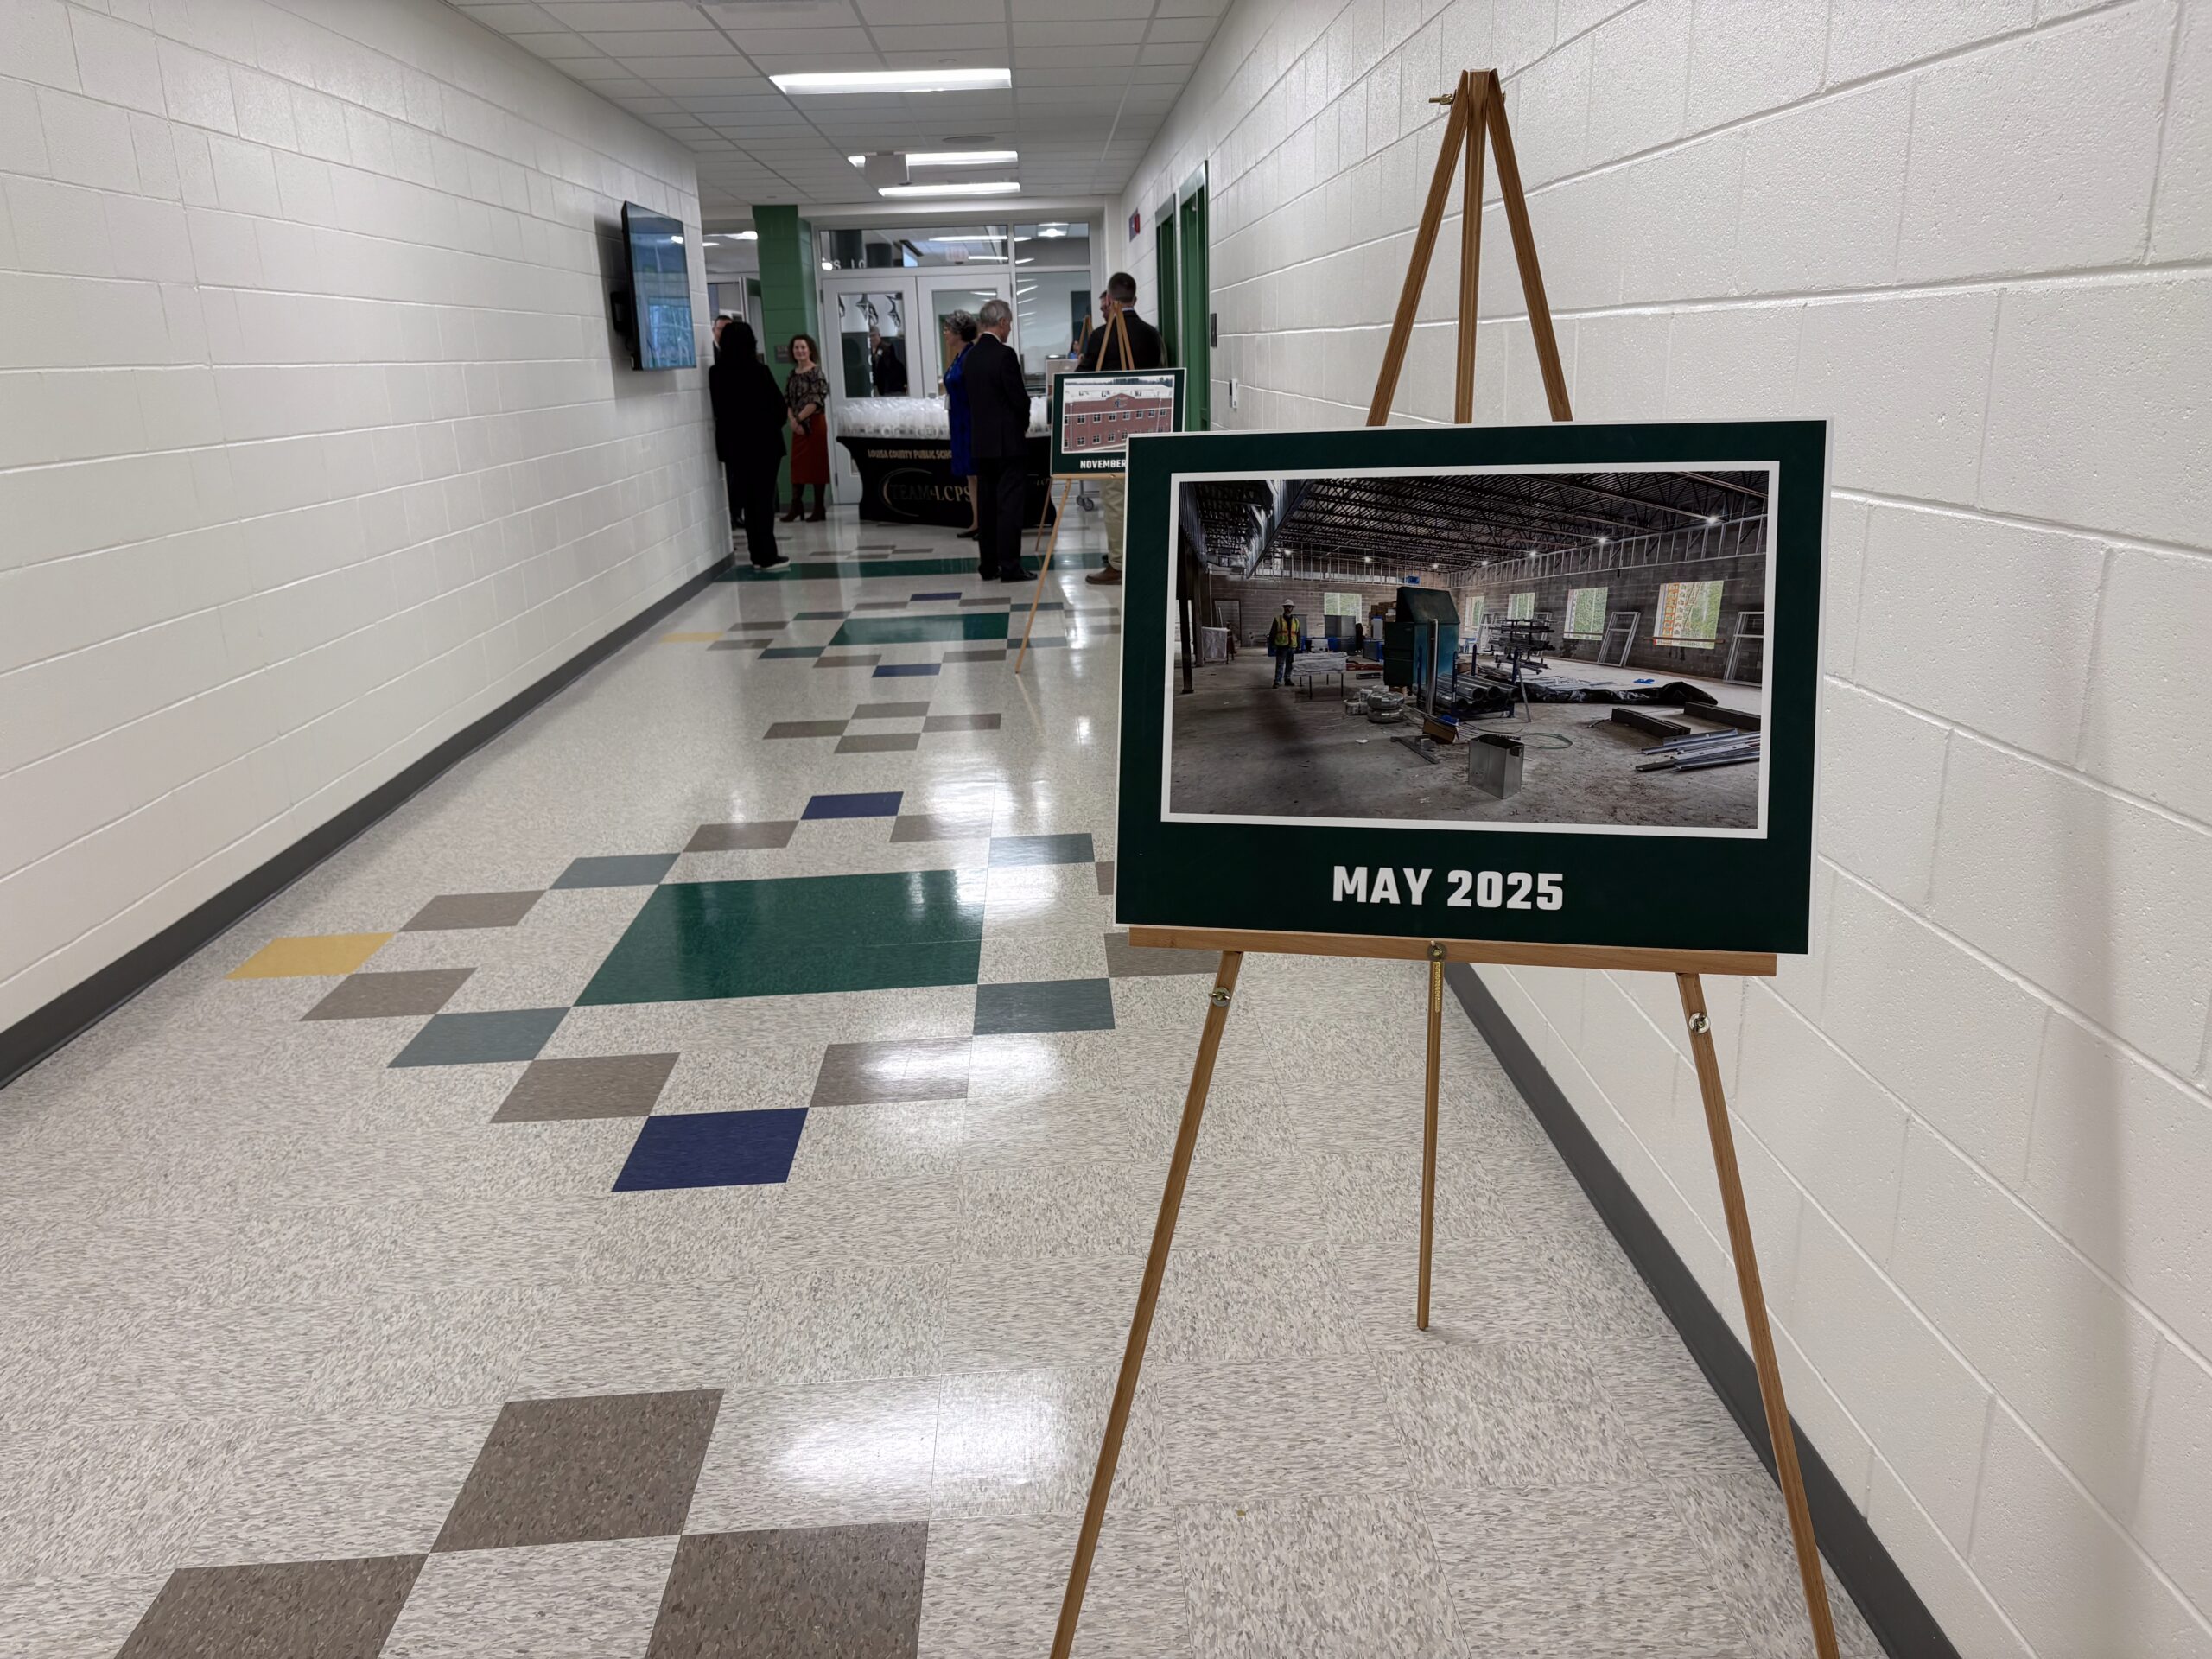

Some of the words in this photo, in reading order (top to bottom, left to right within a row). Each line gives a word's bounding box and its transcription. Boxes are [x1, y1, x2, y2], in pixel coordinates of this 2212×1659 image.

[888, 449, 912, 460] COUNTY
[912, 449, 936, 460] PUBLIC
[1080, 459, 1126, 470] NOVEMBER
[889, 484, 931, 500] TEAM
[933, 485, 970, 502] LCPS
[1333, 866, 1433, 905] MAY
[1447, 869, 1563, 911] 2025
